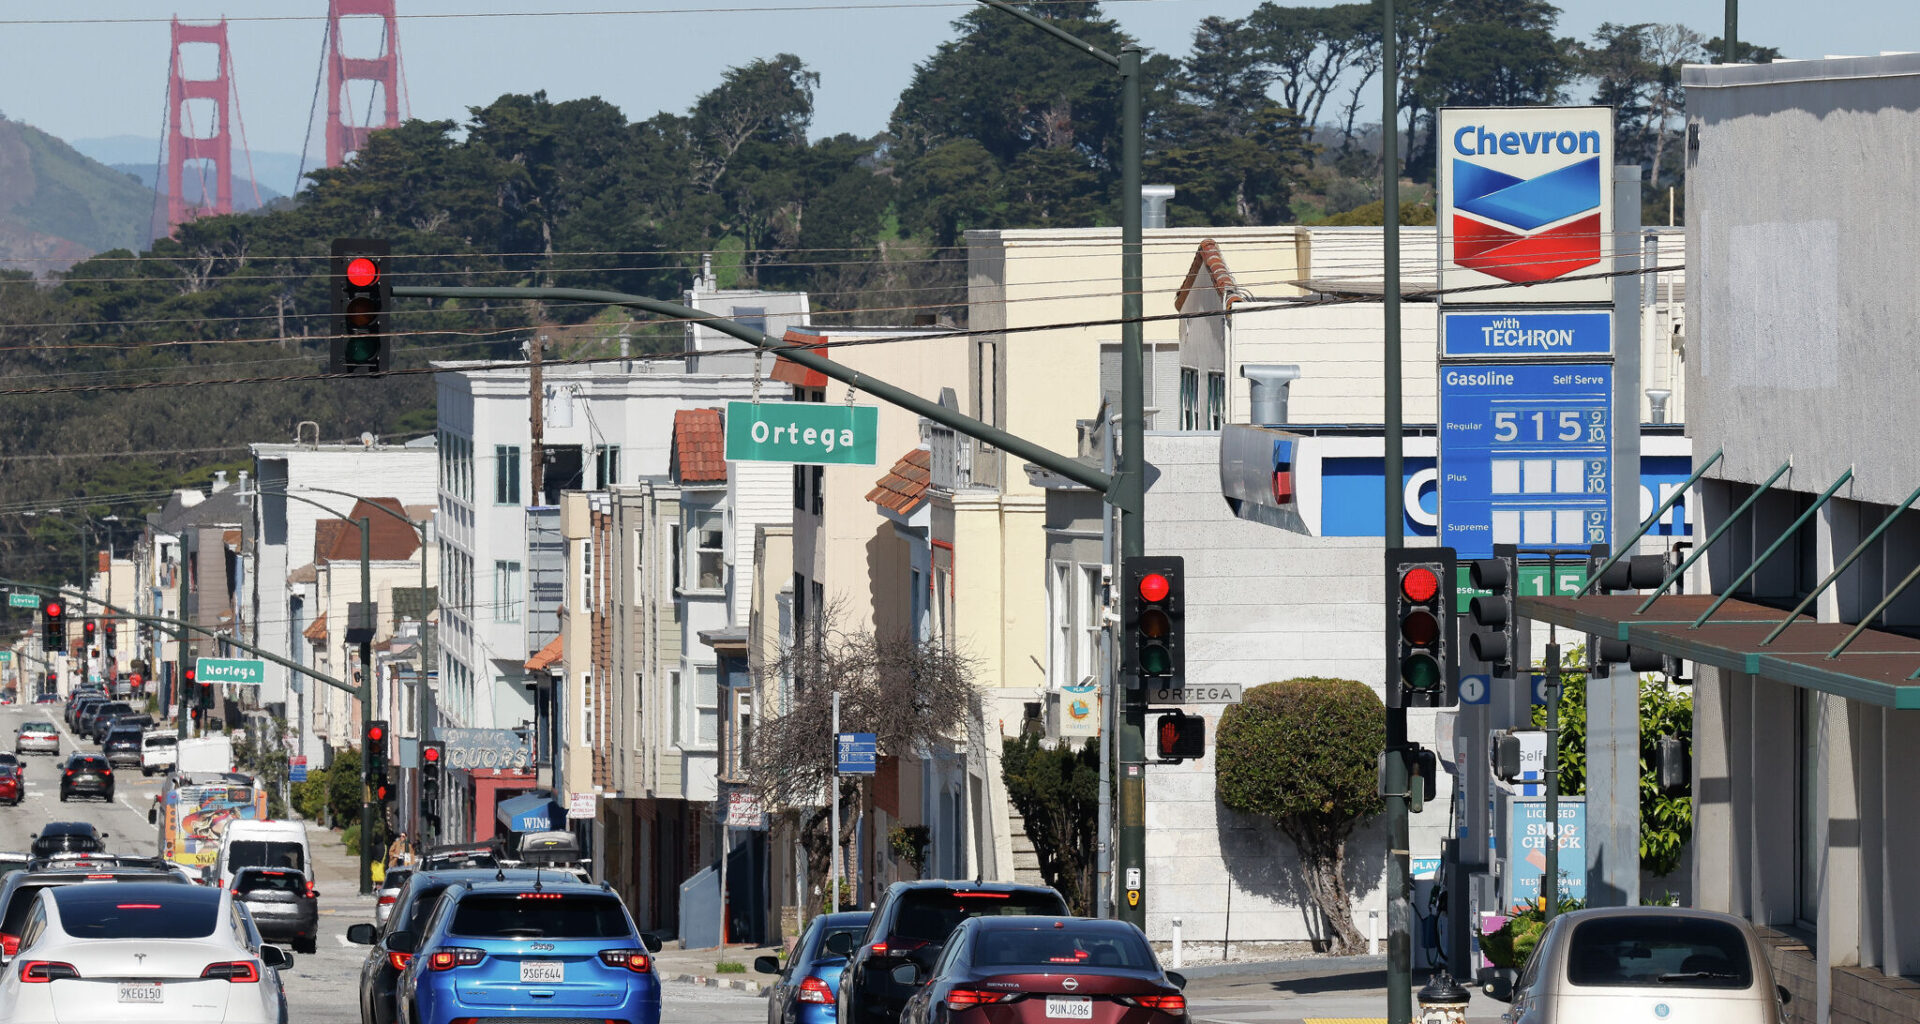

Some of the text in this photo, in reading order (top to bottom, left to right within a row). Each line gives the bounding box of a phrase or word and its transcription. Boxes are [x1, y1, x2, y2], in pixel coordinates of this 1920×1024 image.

[1454, 125, 1600, 156] Chevron
[1493, 317, 1520, 329] with
[1446, 371, 1604, 386] Gasoline Self Serve
[1446, 423, 1483, 431] Regular
[751, 420, 854, 453] Ortega
[1447, 474, 1467, 482] Plus
[1447, 523, 1489, 532] Supreme
[206, 664, 256, 680] Noriega
[1157, 688, 1233, 700] ORTEGA
[1469, 682, 1475, 696] 1
[445, 746, 529, 768] IQUORS
[1519, 750, 1543, 762] Self
[233, 790, 247, 800] 28
[1521, 836, 1581, 849] CHCK
[1414, 861, 1438, 870] PLAY
[523, 968, 561, 979] 9SGF644
[120, 987, 161, 999] 9KEG150
[1049, 1003, 1089, 1016] 9UNJ286
